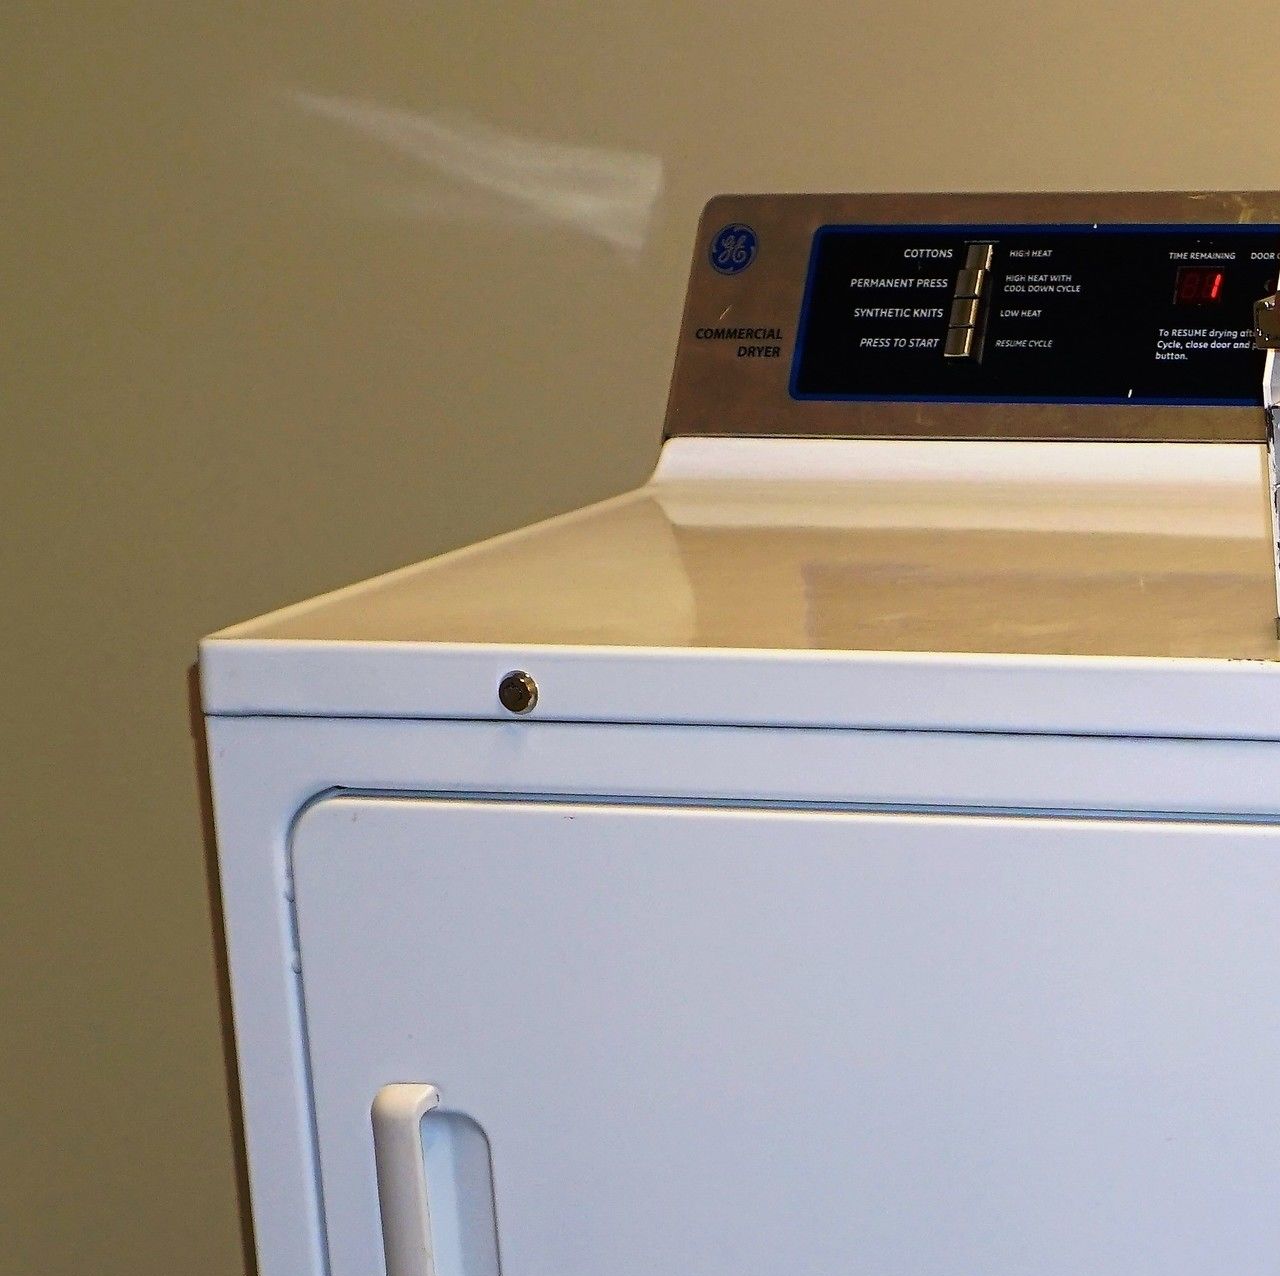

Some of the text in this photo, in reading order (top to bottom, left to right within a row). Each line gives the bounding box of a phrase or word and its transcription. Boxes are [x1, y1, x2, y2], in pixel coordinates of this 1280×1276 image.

[904, 249, 953, 259] COTTONS
[1010, 250, 1053, 258] HIGH HEAT
[1169, 252, 1236, 260] TIME REMAINING
[850, 279, 948, 288] PERMANENT PRESS
[1006, 275, 1072, 283] HIGH HEAT WITH
[1004, 285, 1081, 293] COOL DOWN CYCLE
[854, 308, 944, 318] SYNTHETIC KNITS
[1000, 310, 1042, 318] LOW HEAT
[695, 328, 783, 340] COMMERCIAL
[1158, 329, 1255, 339] To RESUME drying aft
[859, 338, 939, 348] PRESS TO START
[995, 340, 1053, 348] RESUME CYCLE
[1157, 341, 1182, 350] Cycle,
[1185, 341, 1209, 349] close
[1211, 341, 1231, 349] door
[1233, 341, 1250, 349] and
[736, 346, 780, 358] DRYER
[1155, 352, 1188, 361] button.
